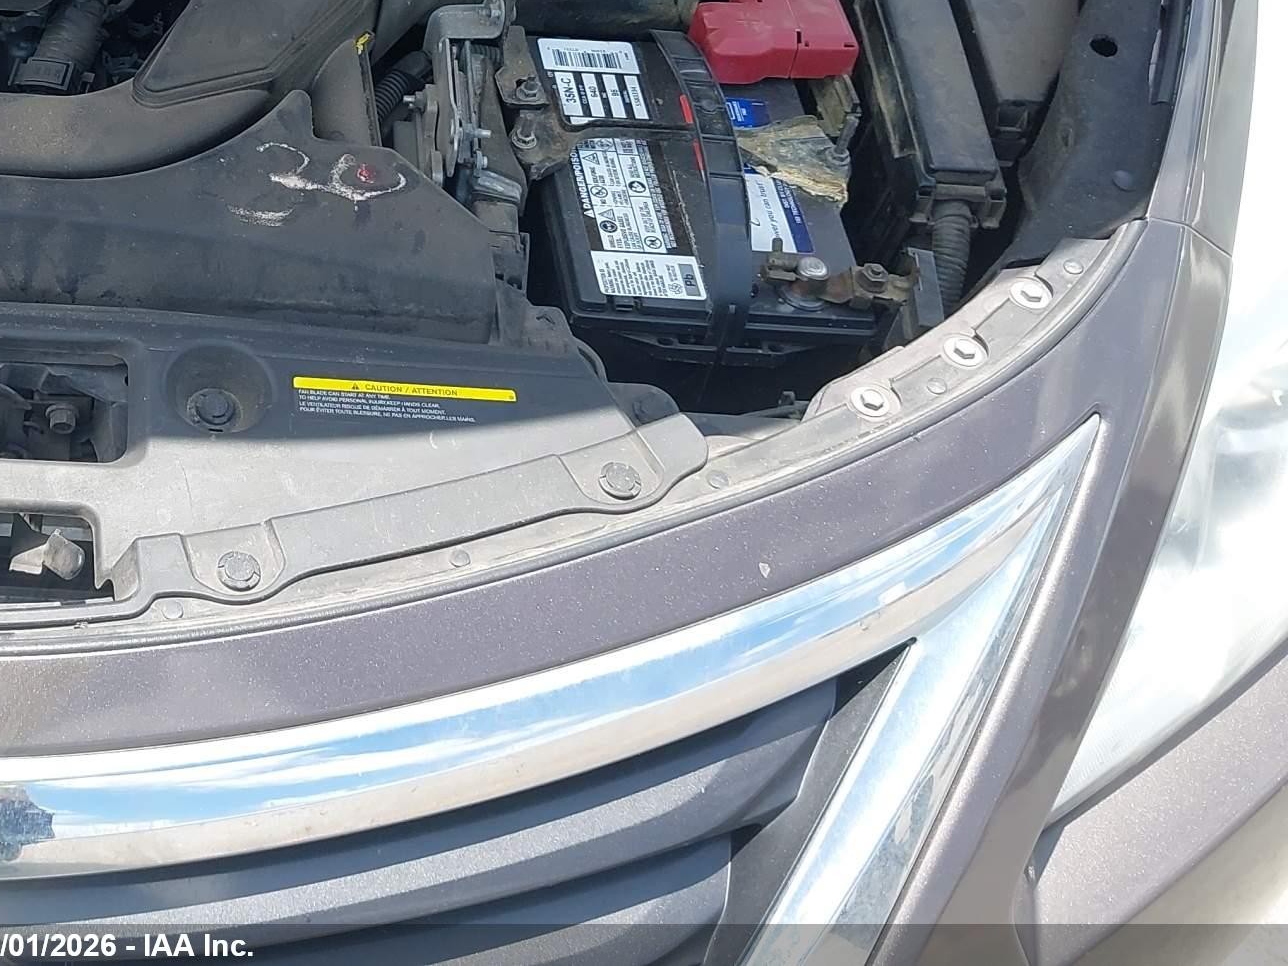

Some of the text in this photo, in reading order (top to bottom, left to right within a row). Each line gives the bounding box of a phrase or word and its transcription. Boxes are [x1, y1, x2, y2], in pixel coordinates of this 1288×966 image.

[560, 77, 577, 103] 35N-C
[762, 198, 771, 210] can
[766, 210, 778, 223] you
[682, 274, 696, 287] Pb
[365, 384, 402, 393] CAUTION
[412, 387, 458, 396] ATTENTION
